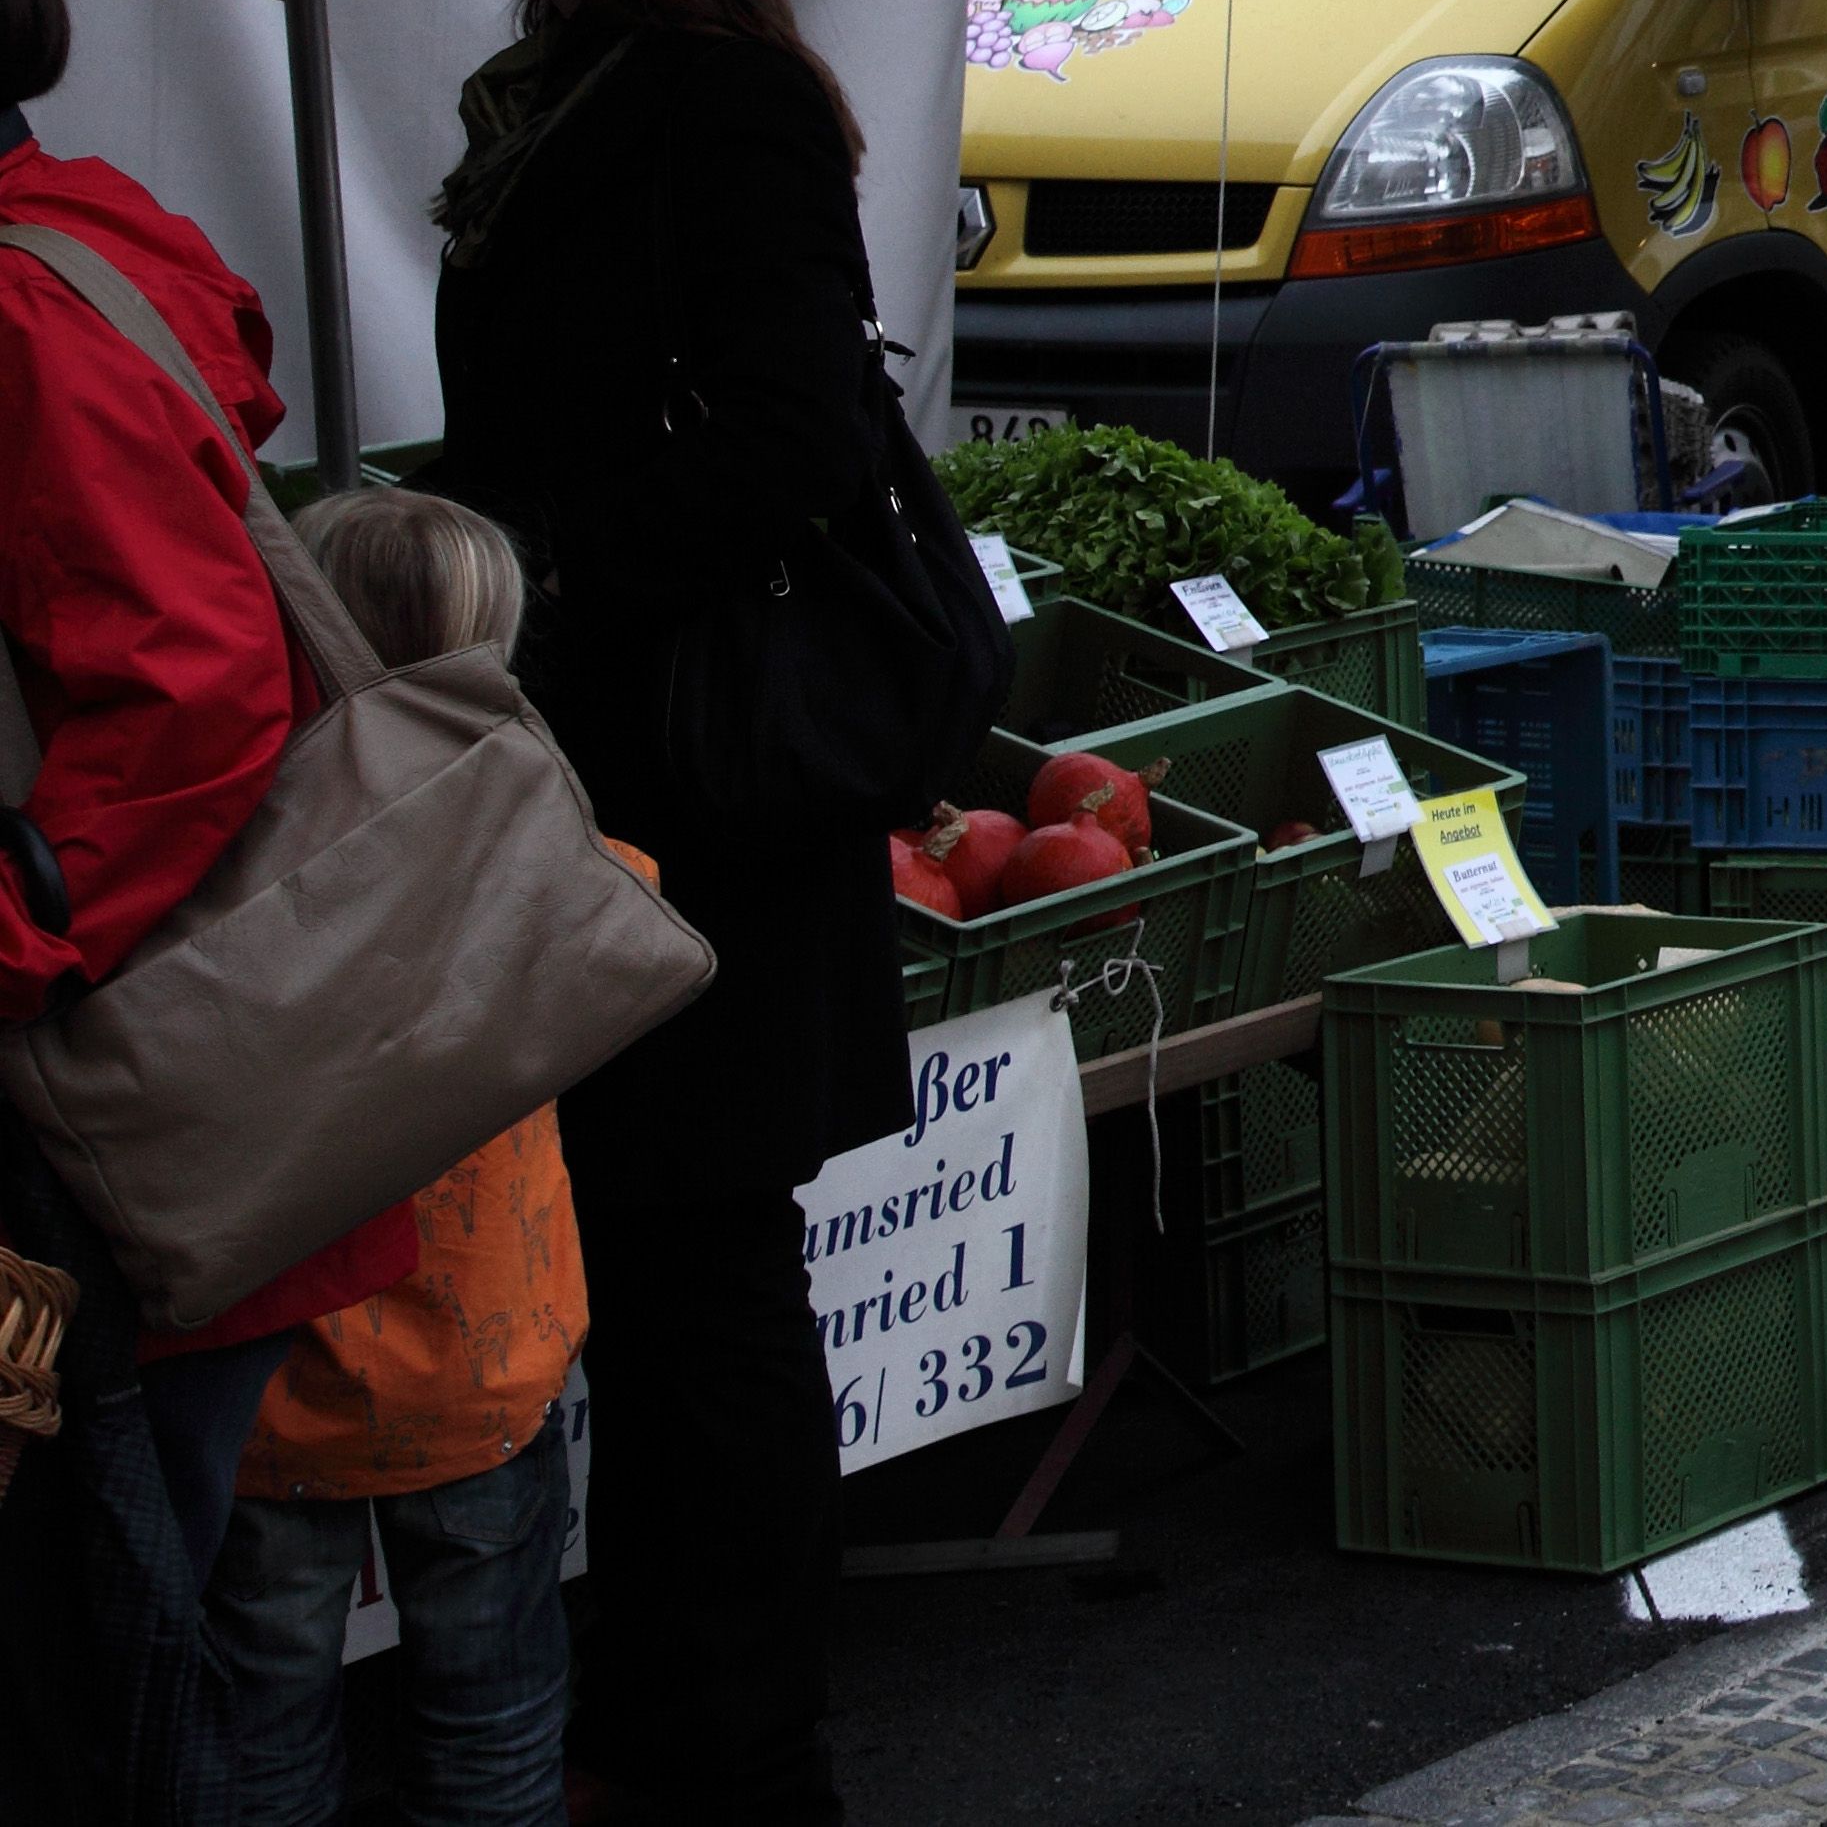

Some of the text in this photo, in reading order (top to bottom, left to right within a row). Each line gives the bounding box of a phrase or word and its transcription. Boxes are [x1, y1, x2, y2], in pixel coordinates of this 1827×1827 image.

[1431, 802, 1476, 822] Heute im
[1440, 824, 1482, 845] Angebot
[904, 1051, 1011, 1148] ßer
[1000, 1221, 1035, 1293] 1
[916, 1319, 1048, 1418] 332
